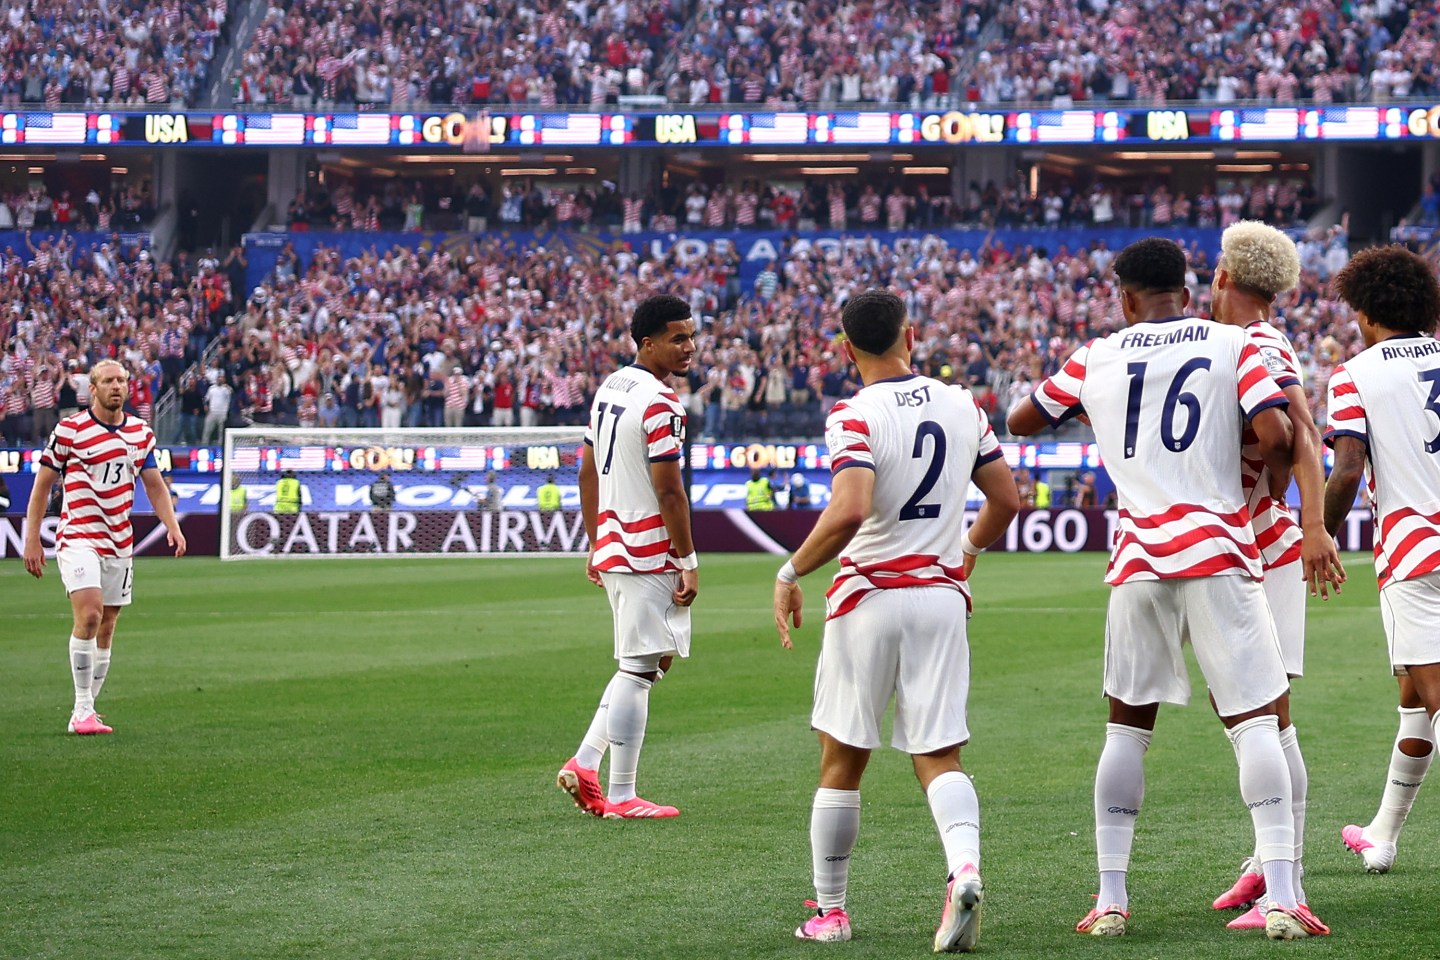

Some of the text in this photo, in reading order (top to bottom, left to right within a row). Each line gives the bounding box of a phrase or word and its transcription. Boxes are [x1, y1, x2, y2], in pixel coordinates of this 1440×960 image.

[145, 113, 187, 143] USA
[655, 114, 697, 143] USA
[920, 110, 1004, 143] GOAL!
[1148, 111, 1189, 140] USA
[1120, 325, 1210, 349] FREEMAN
[894, 384, 933, 408] DEST
[1124, 356, 1213, 459] 16
[596, 401, 627, 475] 17
[526, 445, 560, 469] USA
[730, 445, 796, 470] GOAL!
[898, 420, 947, 522] 2
[103, 461, 124, 485] 13
[235, 511, 417, 554] QATAR
[1005, 508, 1089, 553] 160
